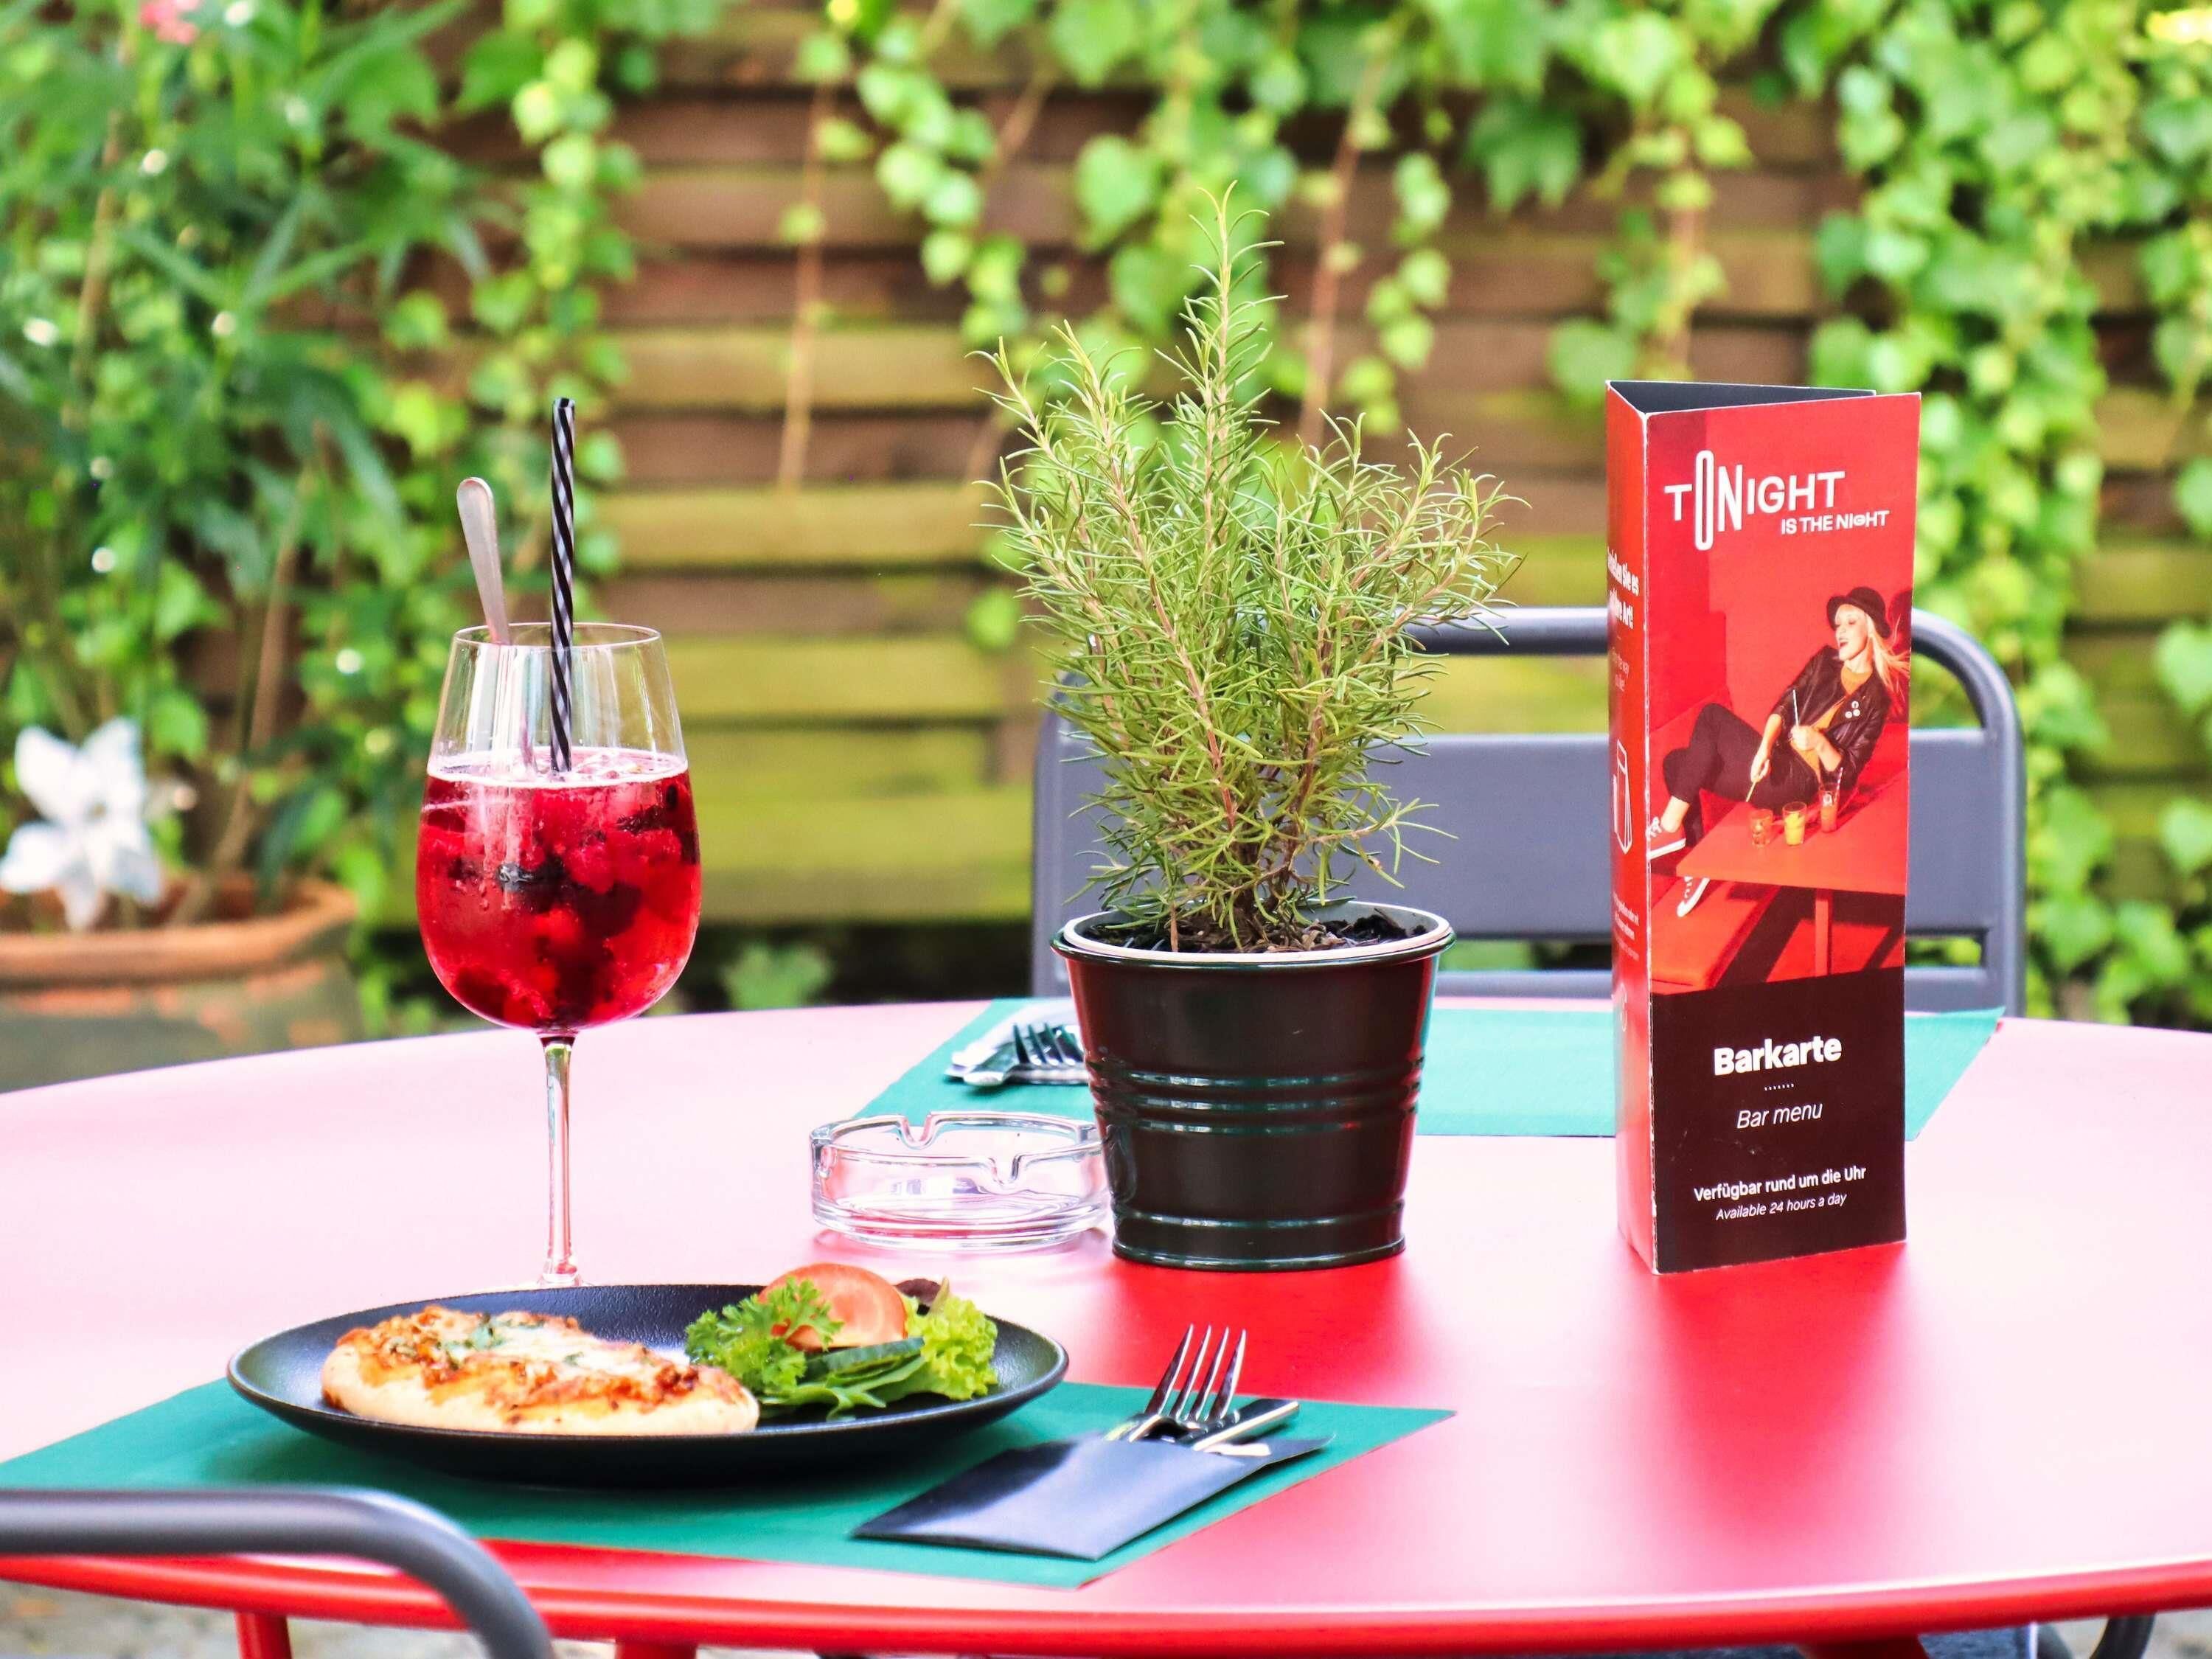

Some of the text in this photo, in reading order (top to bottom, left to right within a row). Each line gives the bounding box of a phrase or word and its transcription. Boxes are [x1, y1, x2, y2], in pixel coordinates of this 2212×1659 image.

[1663, 450, 1845, 551] TONIGHT
[1781, 510, 1890, 535] IS THE NIGHT
[1714, 1035, 1843, 1076] Barkarte
[1736, 1103, 1823, 1129] Bar menu
[1694, 1165, 1866, 1201] Verfügbar rund um die Uhr
[1716, 1192, 1848, 1221] Available 24 hours a day
